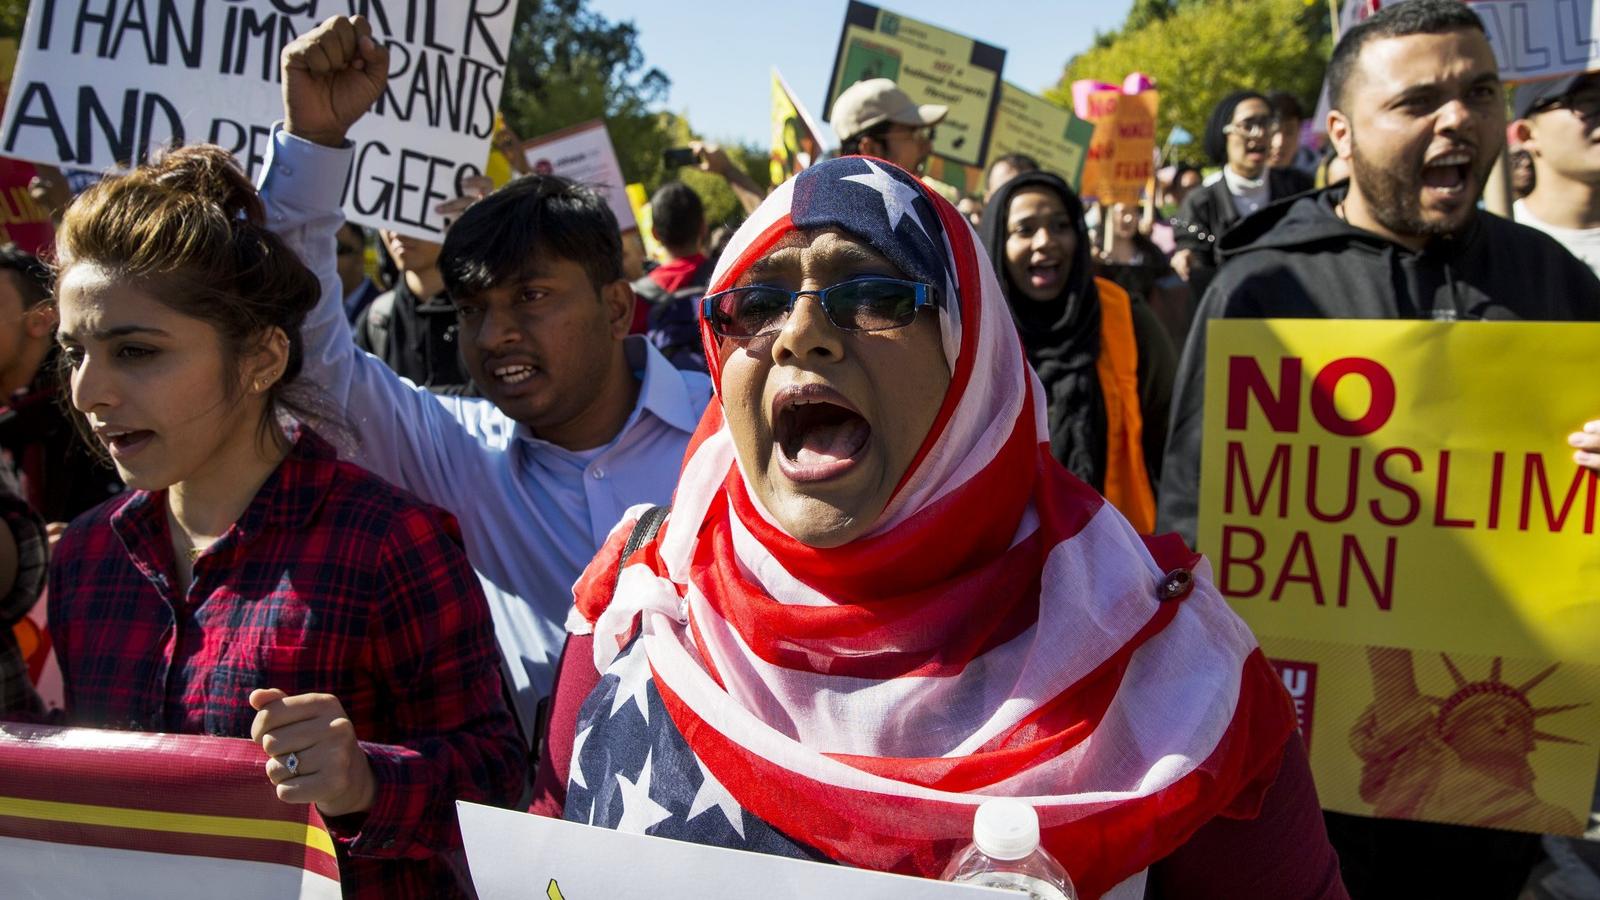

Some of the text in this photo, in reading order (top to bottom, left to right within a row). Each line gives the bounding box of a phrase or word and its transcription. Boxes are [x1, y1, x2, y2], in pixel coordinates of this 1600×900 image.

[4, 81, 186, 169] AND
[1225, 355, 1396, 437] NO
[1223, 441, 1598, 534] MUSLIM
[1219, 524, 1397, 612] BAN
